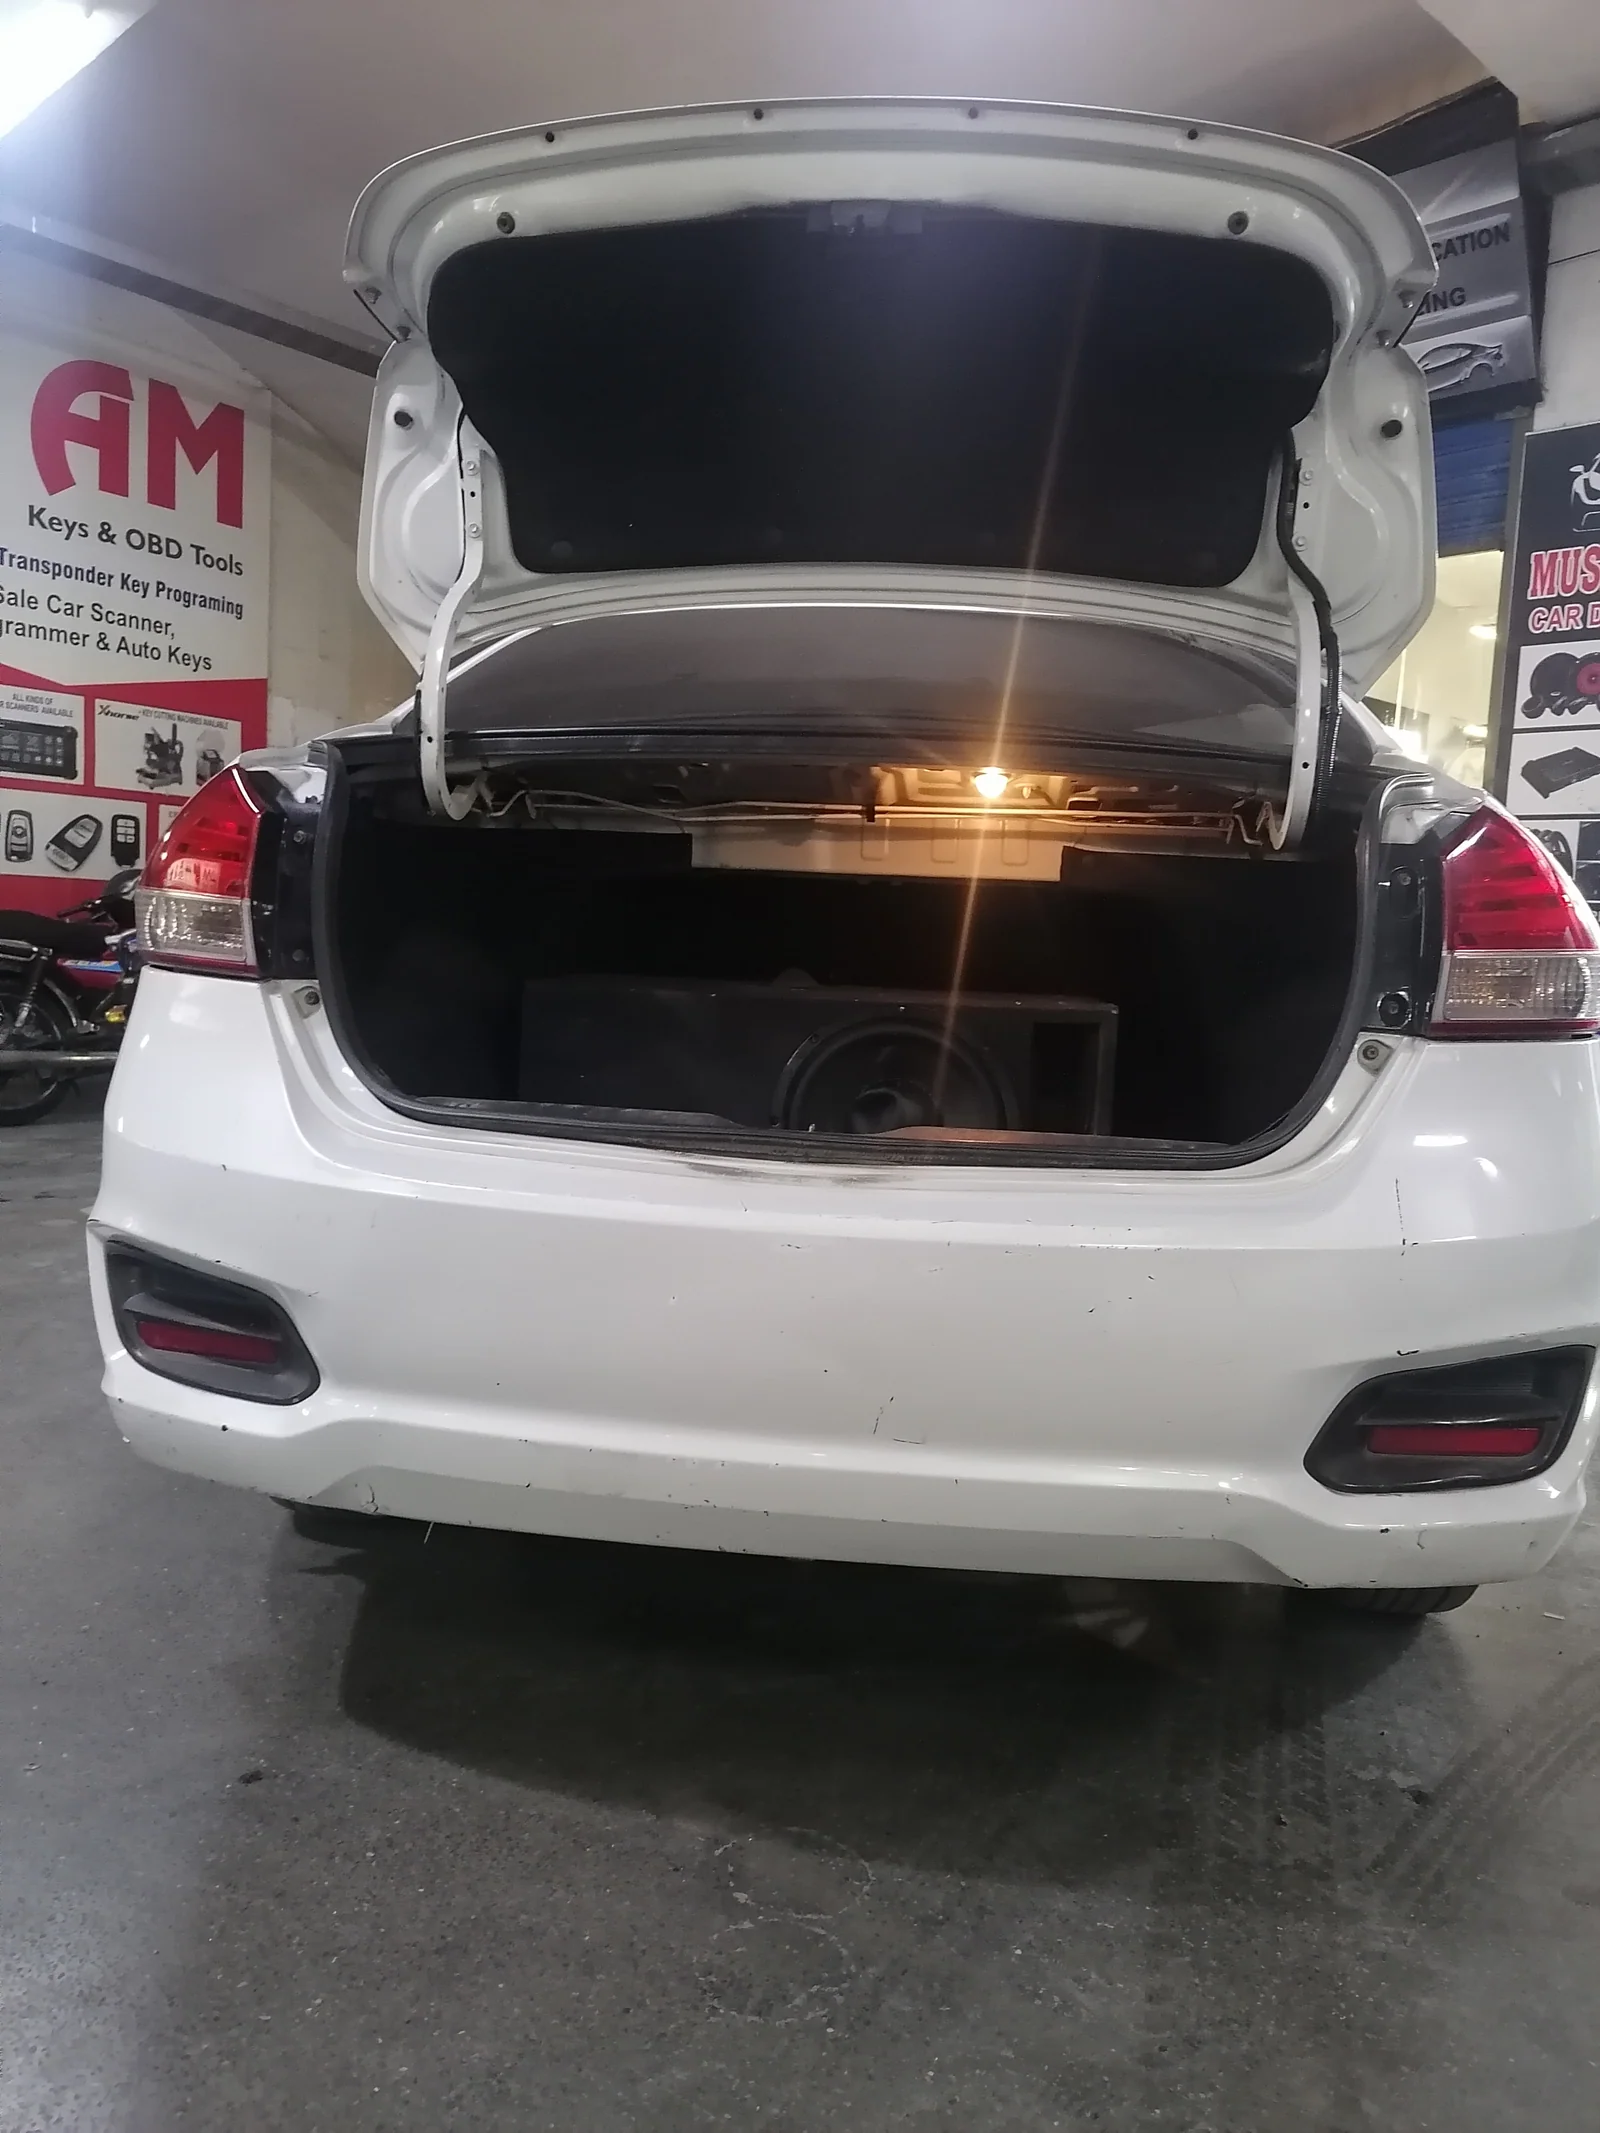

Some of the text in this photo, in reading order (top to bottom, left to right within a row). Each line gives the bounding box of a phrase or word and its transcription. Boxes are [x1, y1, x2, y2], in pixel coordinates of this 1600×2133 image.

[30, 359, 245, 530] AM
[28, 504, 244, 576] Keys & OBD Tools
[0, 546, 244, 620] Transponder Key Programing
[1527, 543, 1600, 600] MUS
[46, 594, 84, 618] Car
[91, 602, 176, 639] Scanner,
[1528, 602, 1584, 634] CAR
[0, 618, 213, 671] rammer & Auto Keys
[41, 706, 74, 718] AVAILABLE
